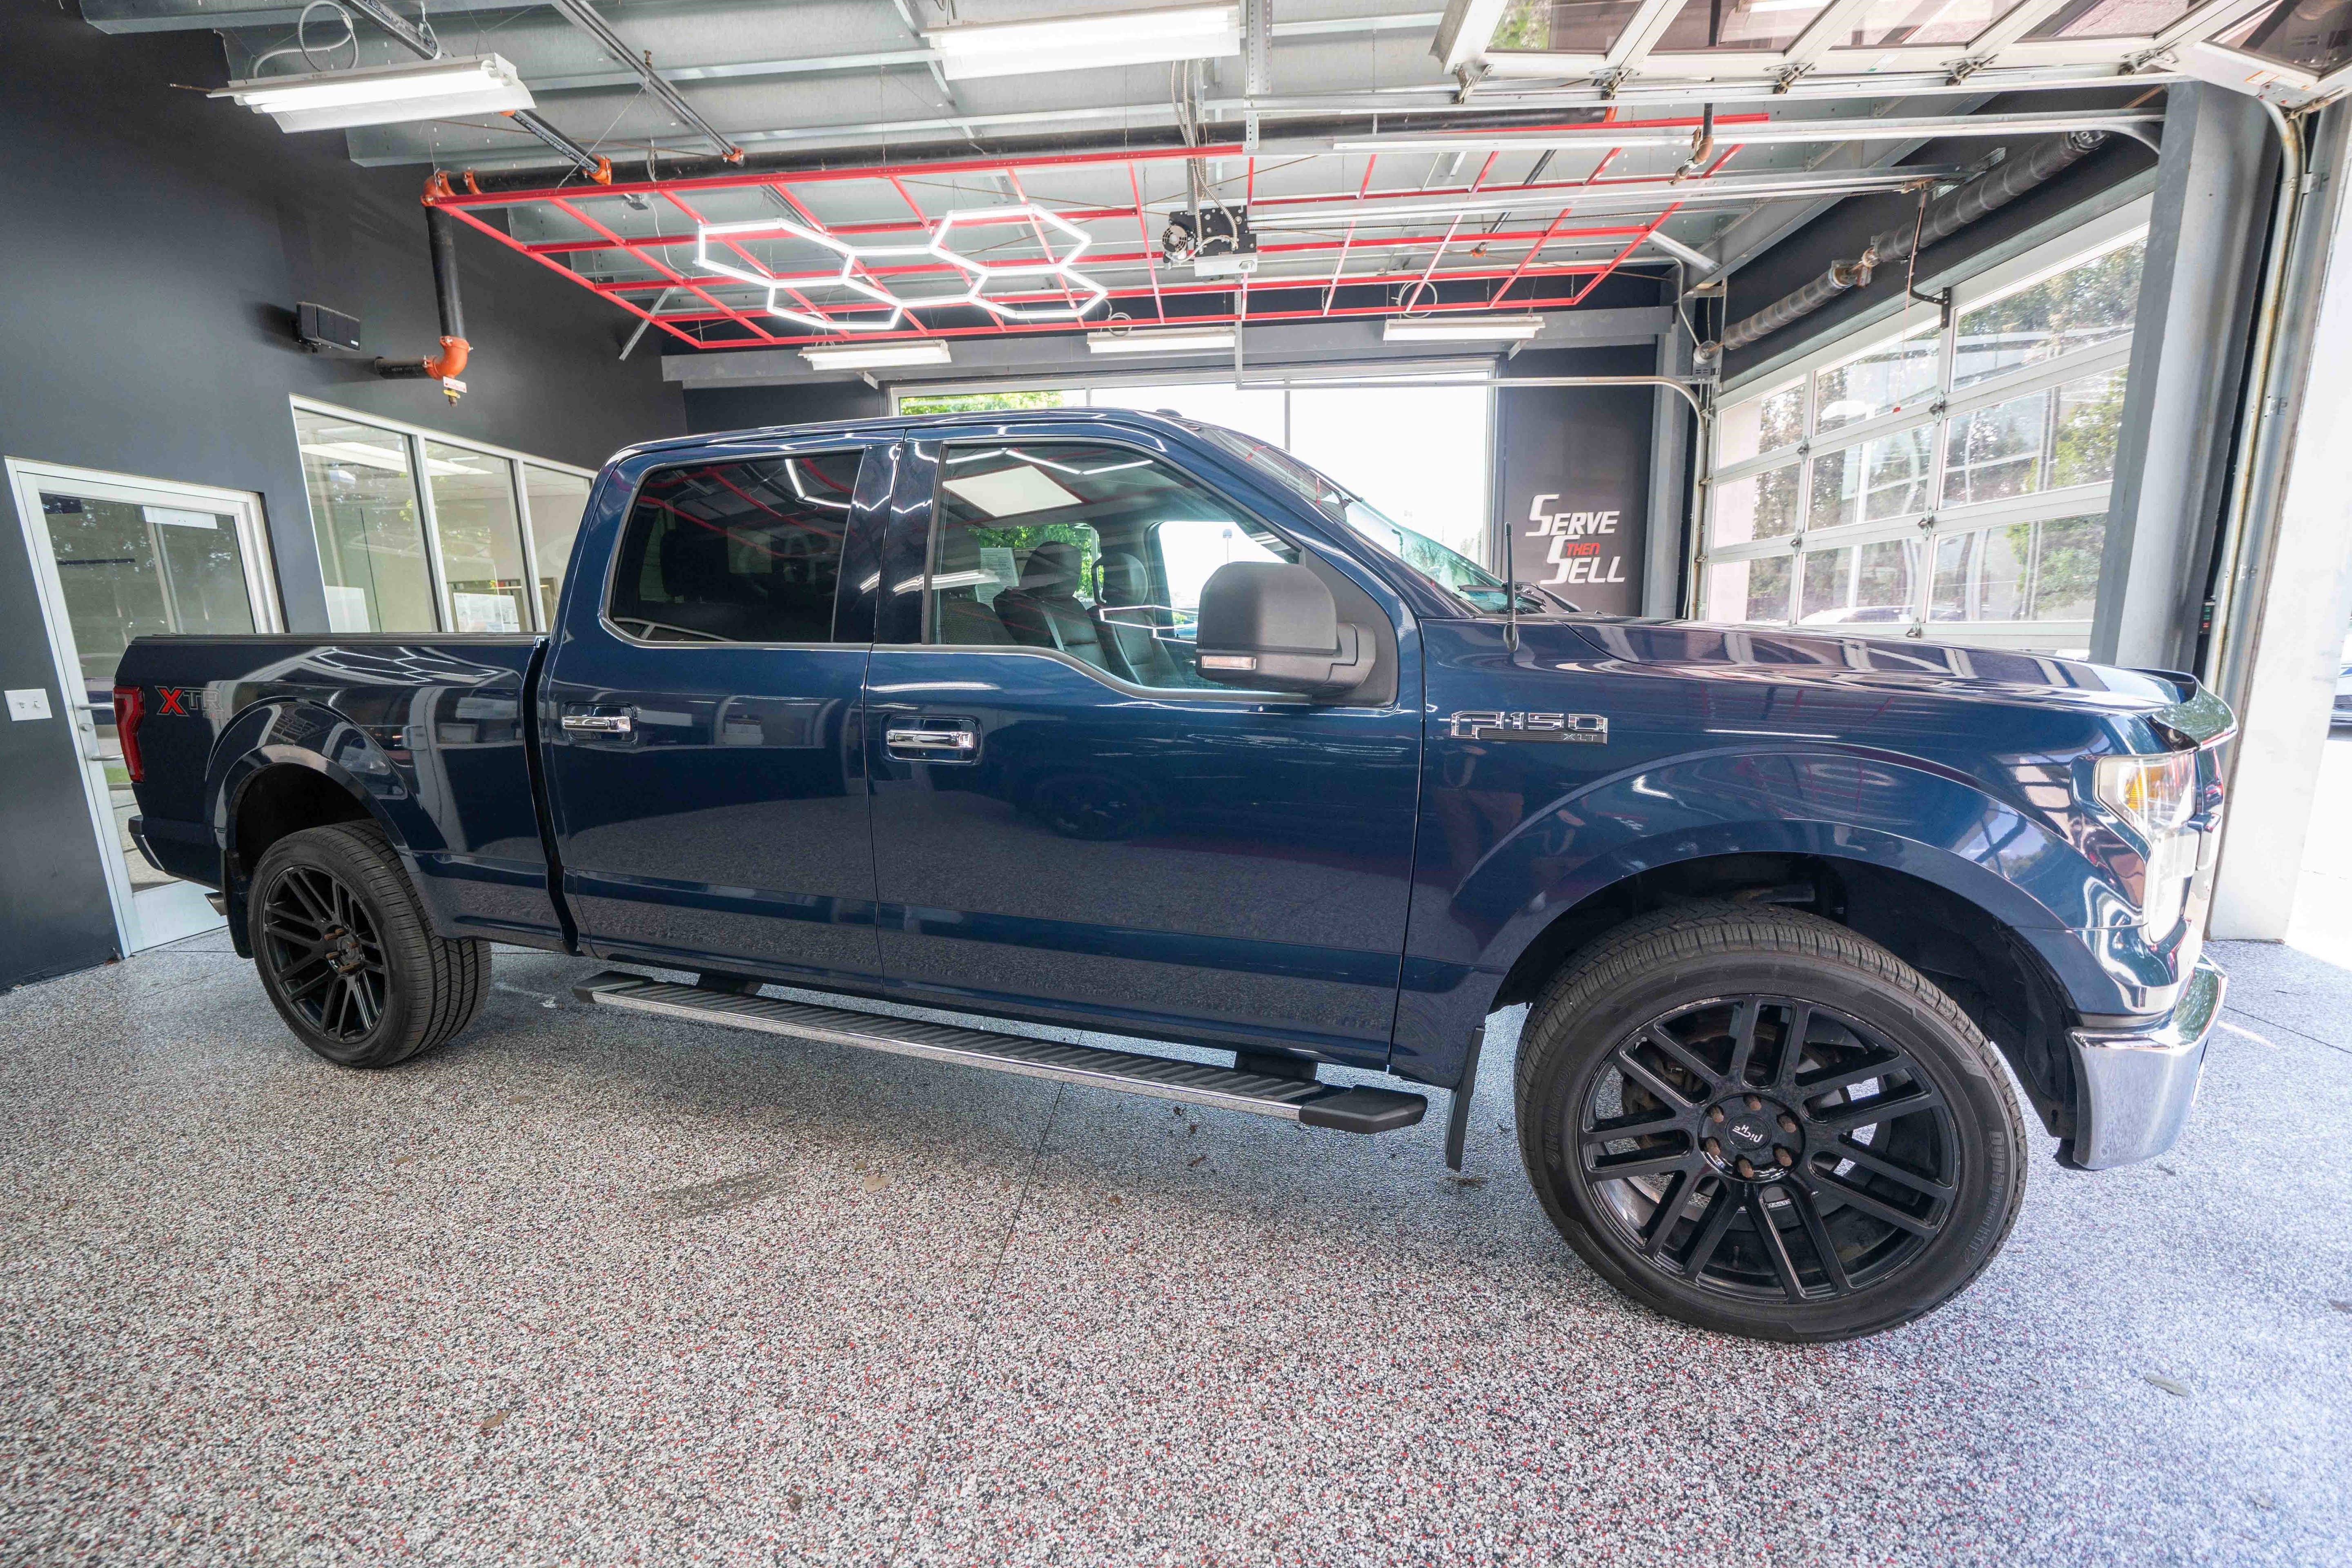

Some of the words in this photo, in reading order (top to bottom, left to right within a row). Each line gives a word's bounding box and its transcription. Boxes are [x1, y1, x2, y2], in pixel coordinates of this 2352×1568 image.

[1525, 494, 1620, 537] SERVE
[1540, 534, 1626, 585] SELL
[154, 686, 224, 717] XTR
[1563, 733, 1597, 742] XLT
